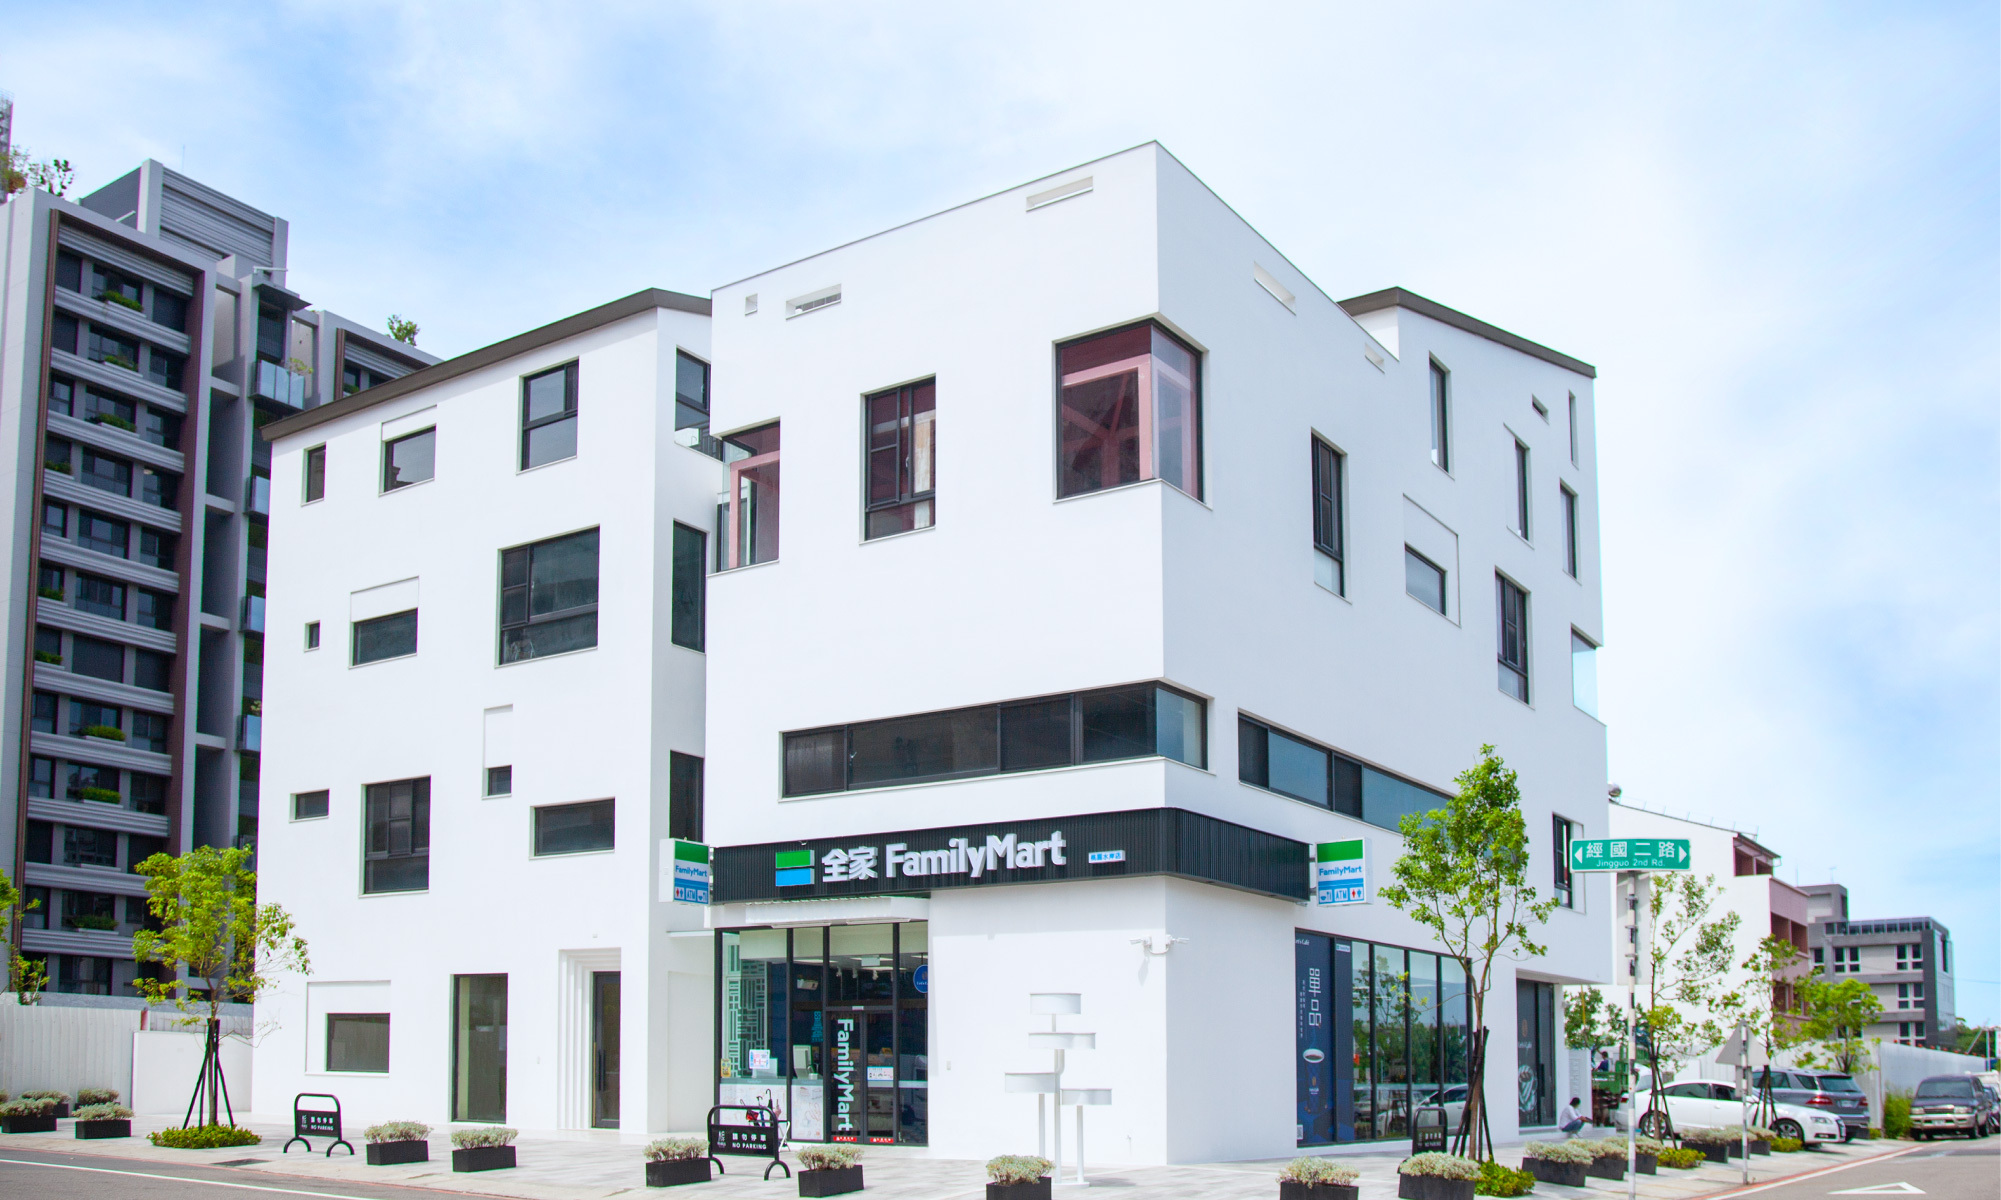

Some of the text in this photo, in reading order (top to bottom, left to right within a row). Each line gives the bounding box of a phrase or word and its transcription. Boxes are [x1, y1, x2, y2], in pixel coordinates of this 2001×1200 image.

[822, 830, 1066, 882] 全家 FamilyMart
[1586, 842, 1675, 858] 經國二路
[675, 865, 708, 877] FamilyMart
[1318, 866, 1362, 876] FamilyMart
[1597, 859, 1666, 869] Jingguo 2nd Rd.
[1336, 890, 1347, 900] ATM
[1308, 968, 1321, 1026] 單品
[833, 1018, 854, 1131] FamilyMart
